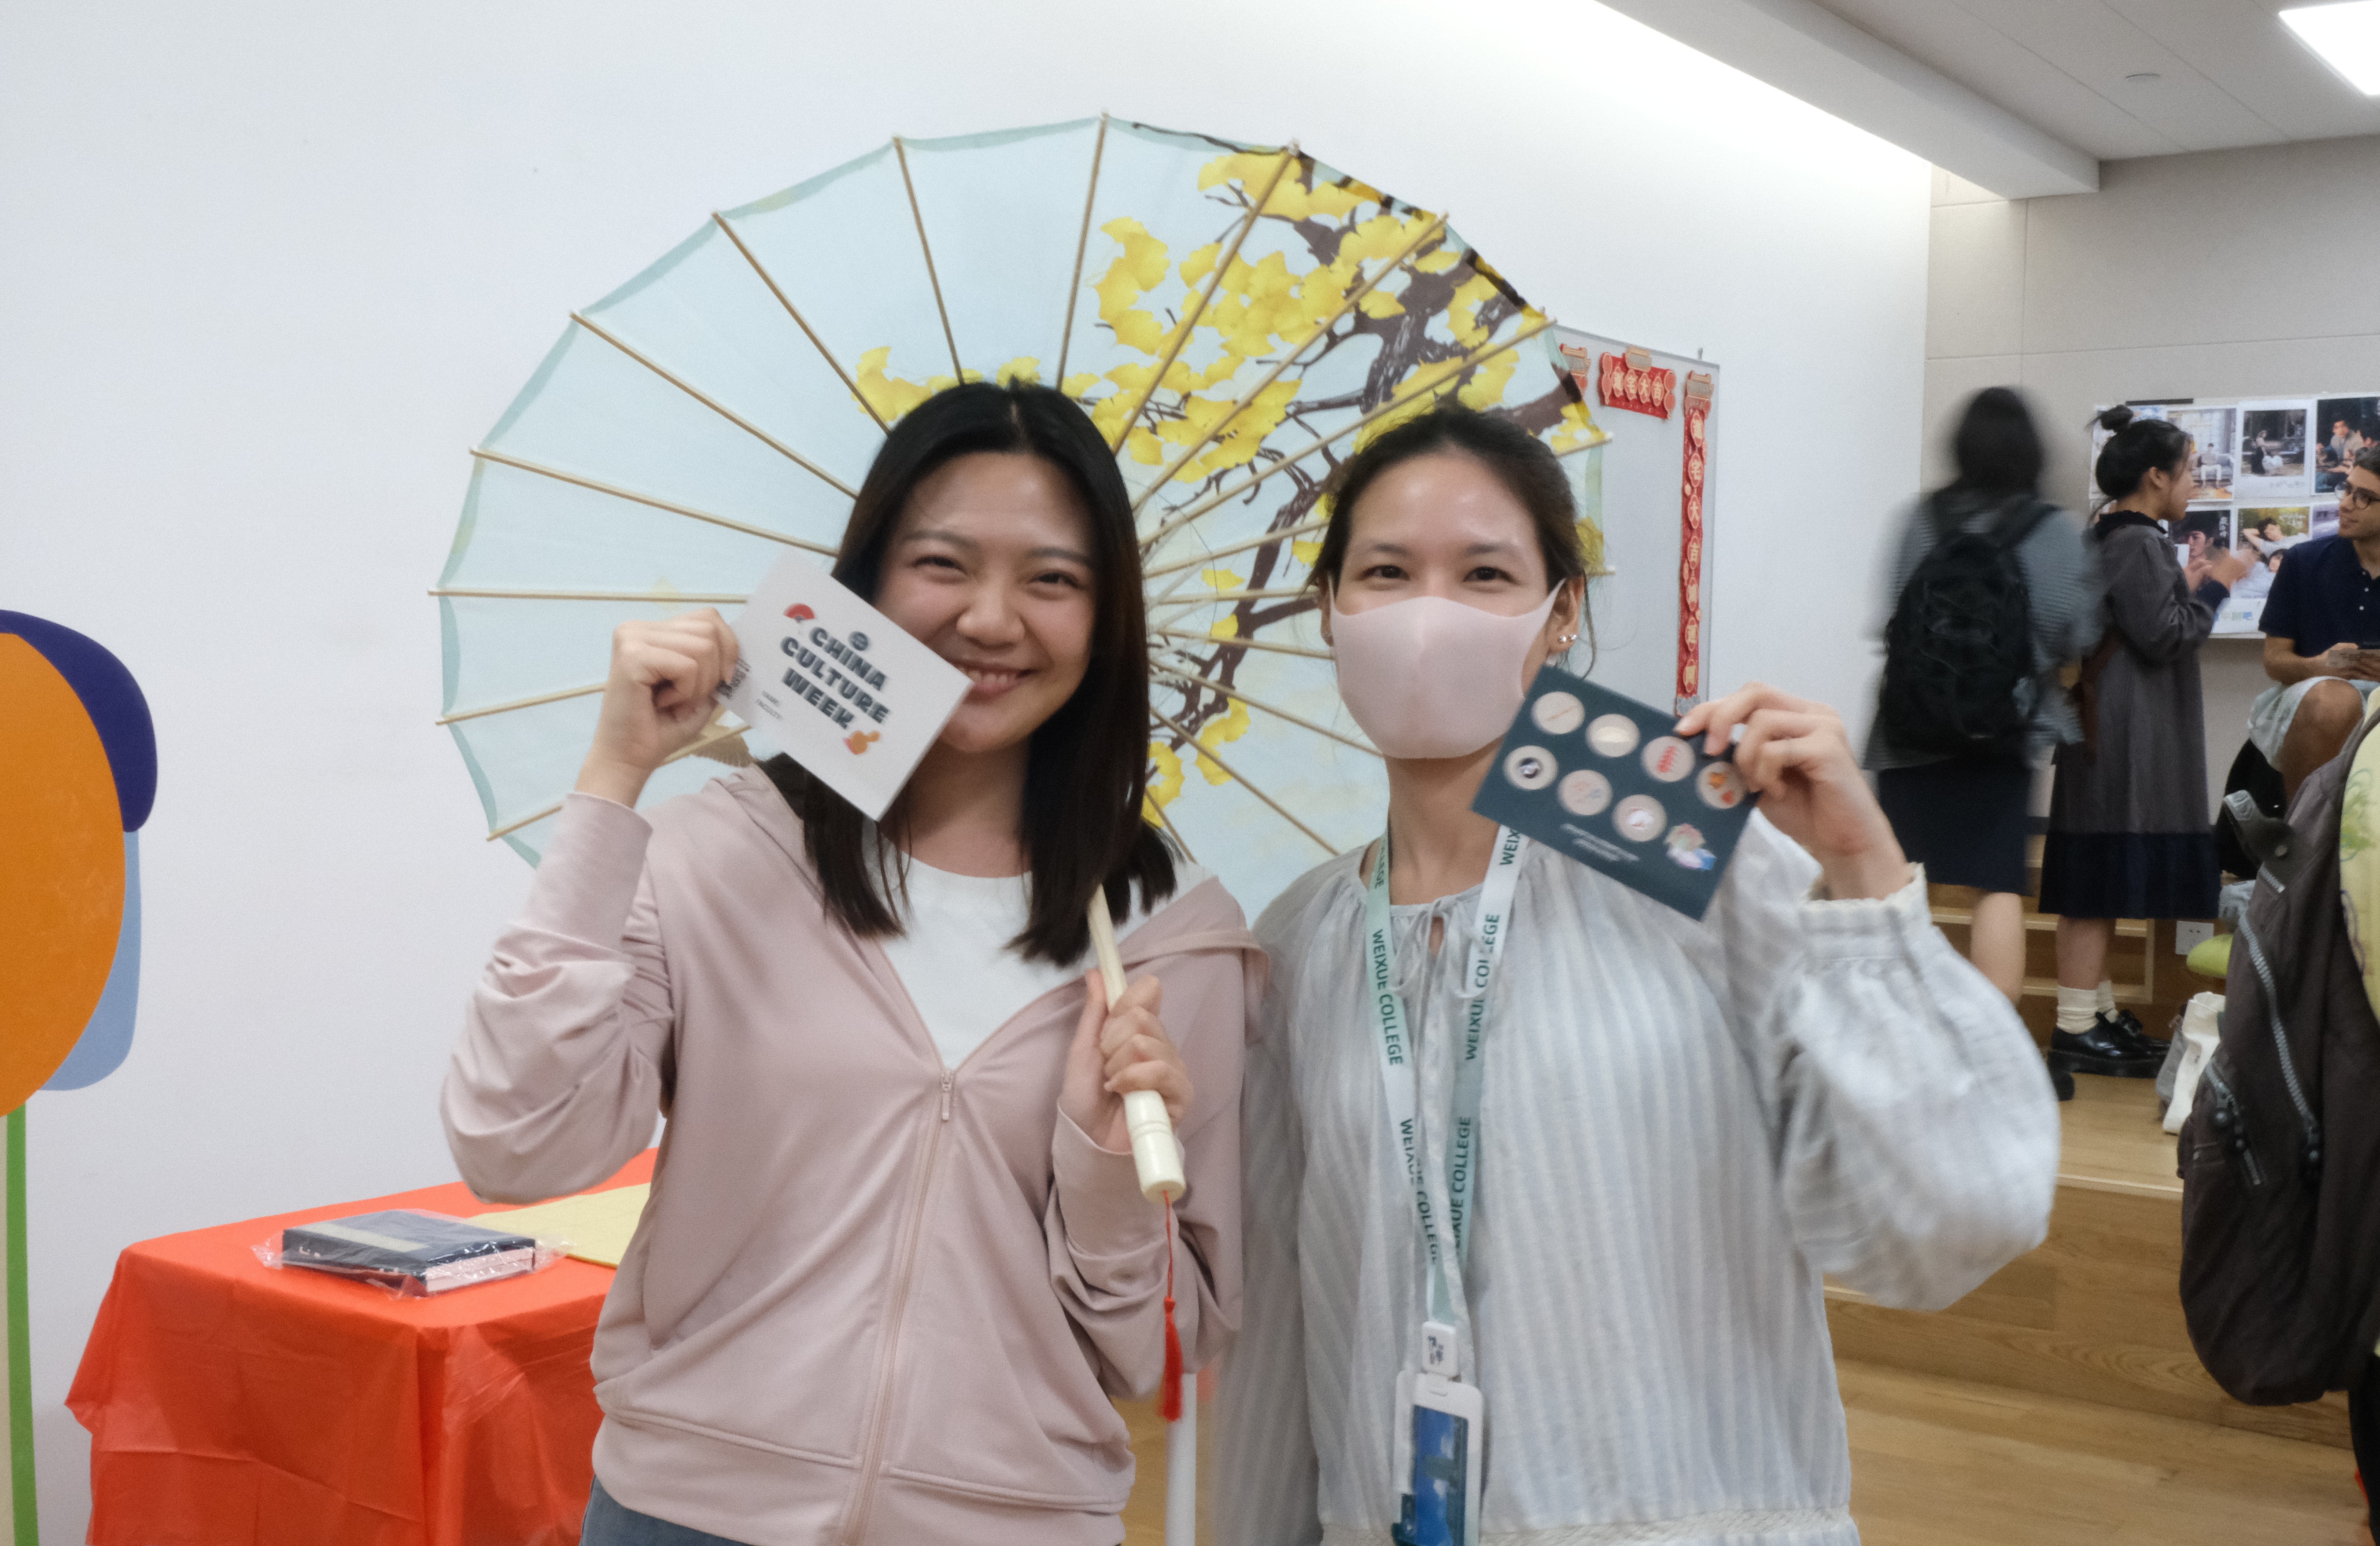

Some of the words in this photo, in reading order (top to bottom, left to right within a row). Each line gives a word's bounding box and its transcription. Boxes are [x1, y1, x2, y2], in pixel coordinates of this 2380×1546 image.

[781, 637, 890, 724] CULTURE
[810, 627, 886, 691] CHINA
[783, 667, 854, 729] WEEK
[1499, 828, 1520, 865] WEIX
[1373, 929, 1388, 990] WEIXUE
[1379, 994, 1404, 1066] COLLEGE
[1453, 1116, 1471, 1193] COLLEGE
